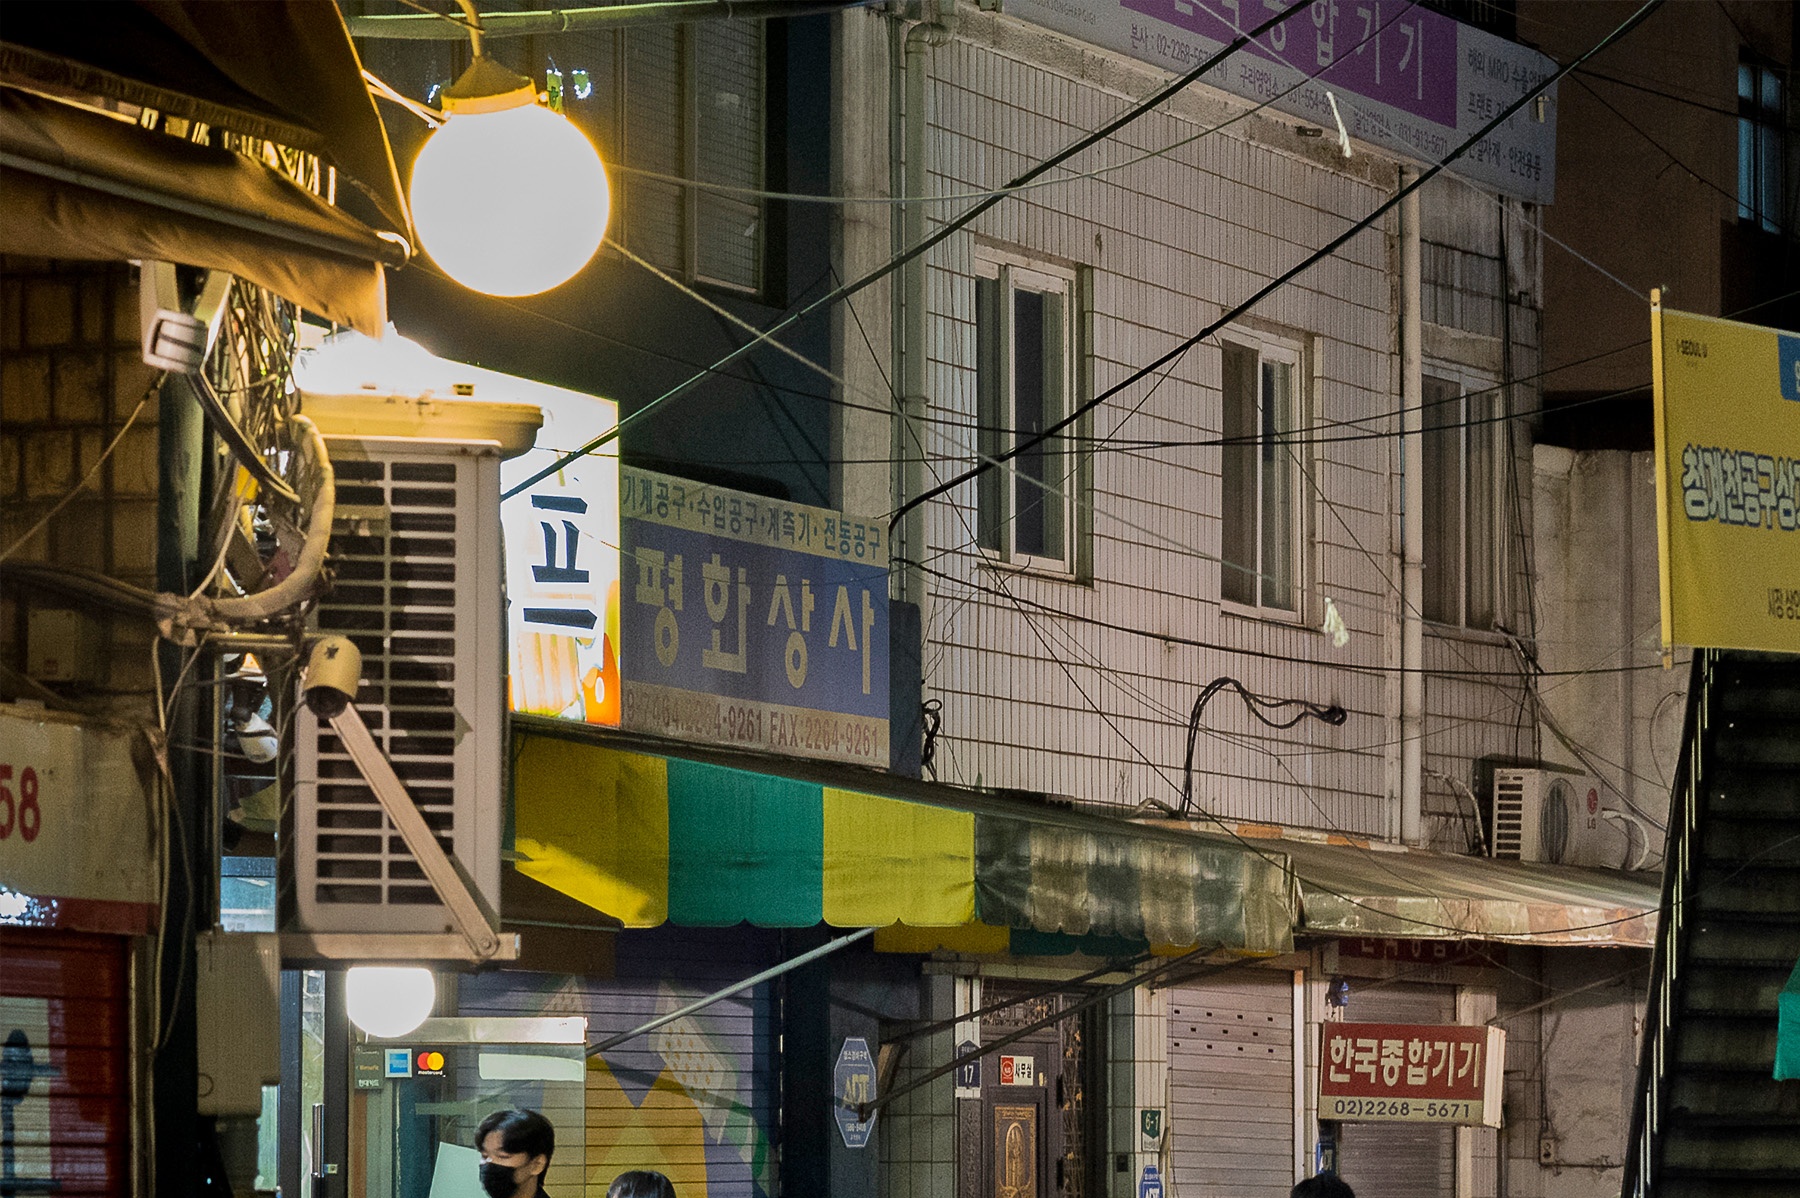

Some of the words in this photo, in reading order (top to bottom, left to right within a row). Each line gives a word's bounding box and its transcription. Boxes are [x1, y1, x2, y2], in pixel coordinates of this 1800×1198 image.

[635, 546, 875, 695] 평화상사
[963, 1064, 974, 1084] 17
[1329, 1035, 1481, 1087] 한국종합기기
[842, 1074, 870, 1110] ADT
[1145, 1113, 1158, 1131] 6-1
[1334, 1100, 1470, 1118] 02)2268-5671
